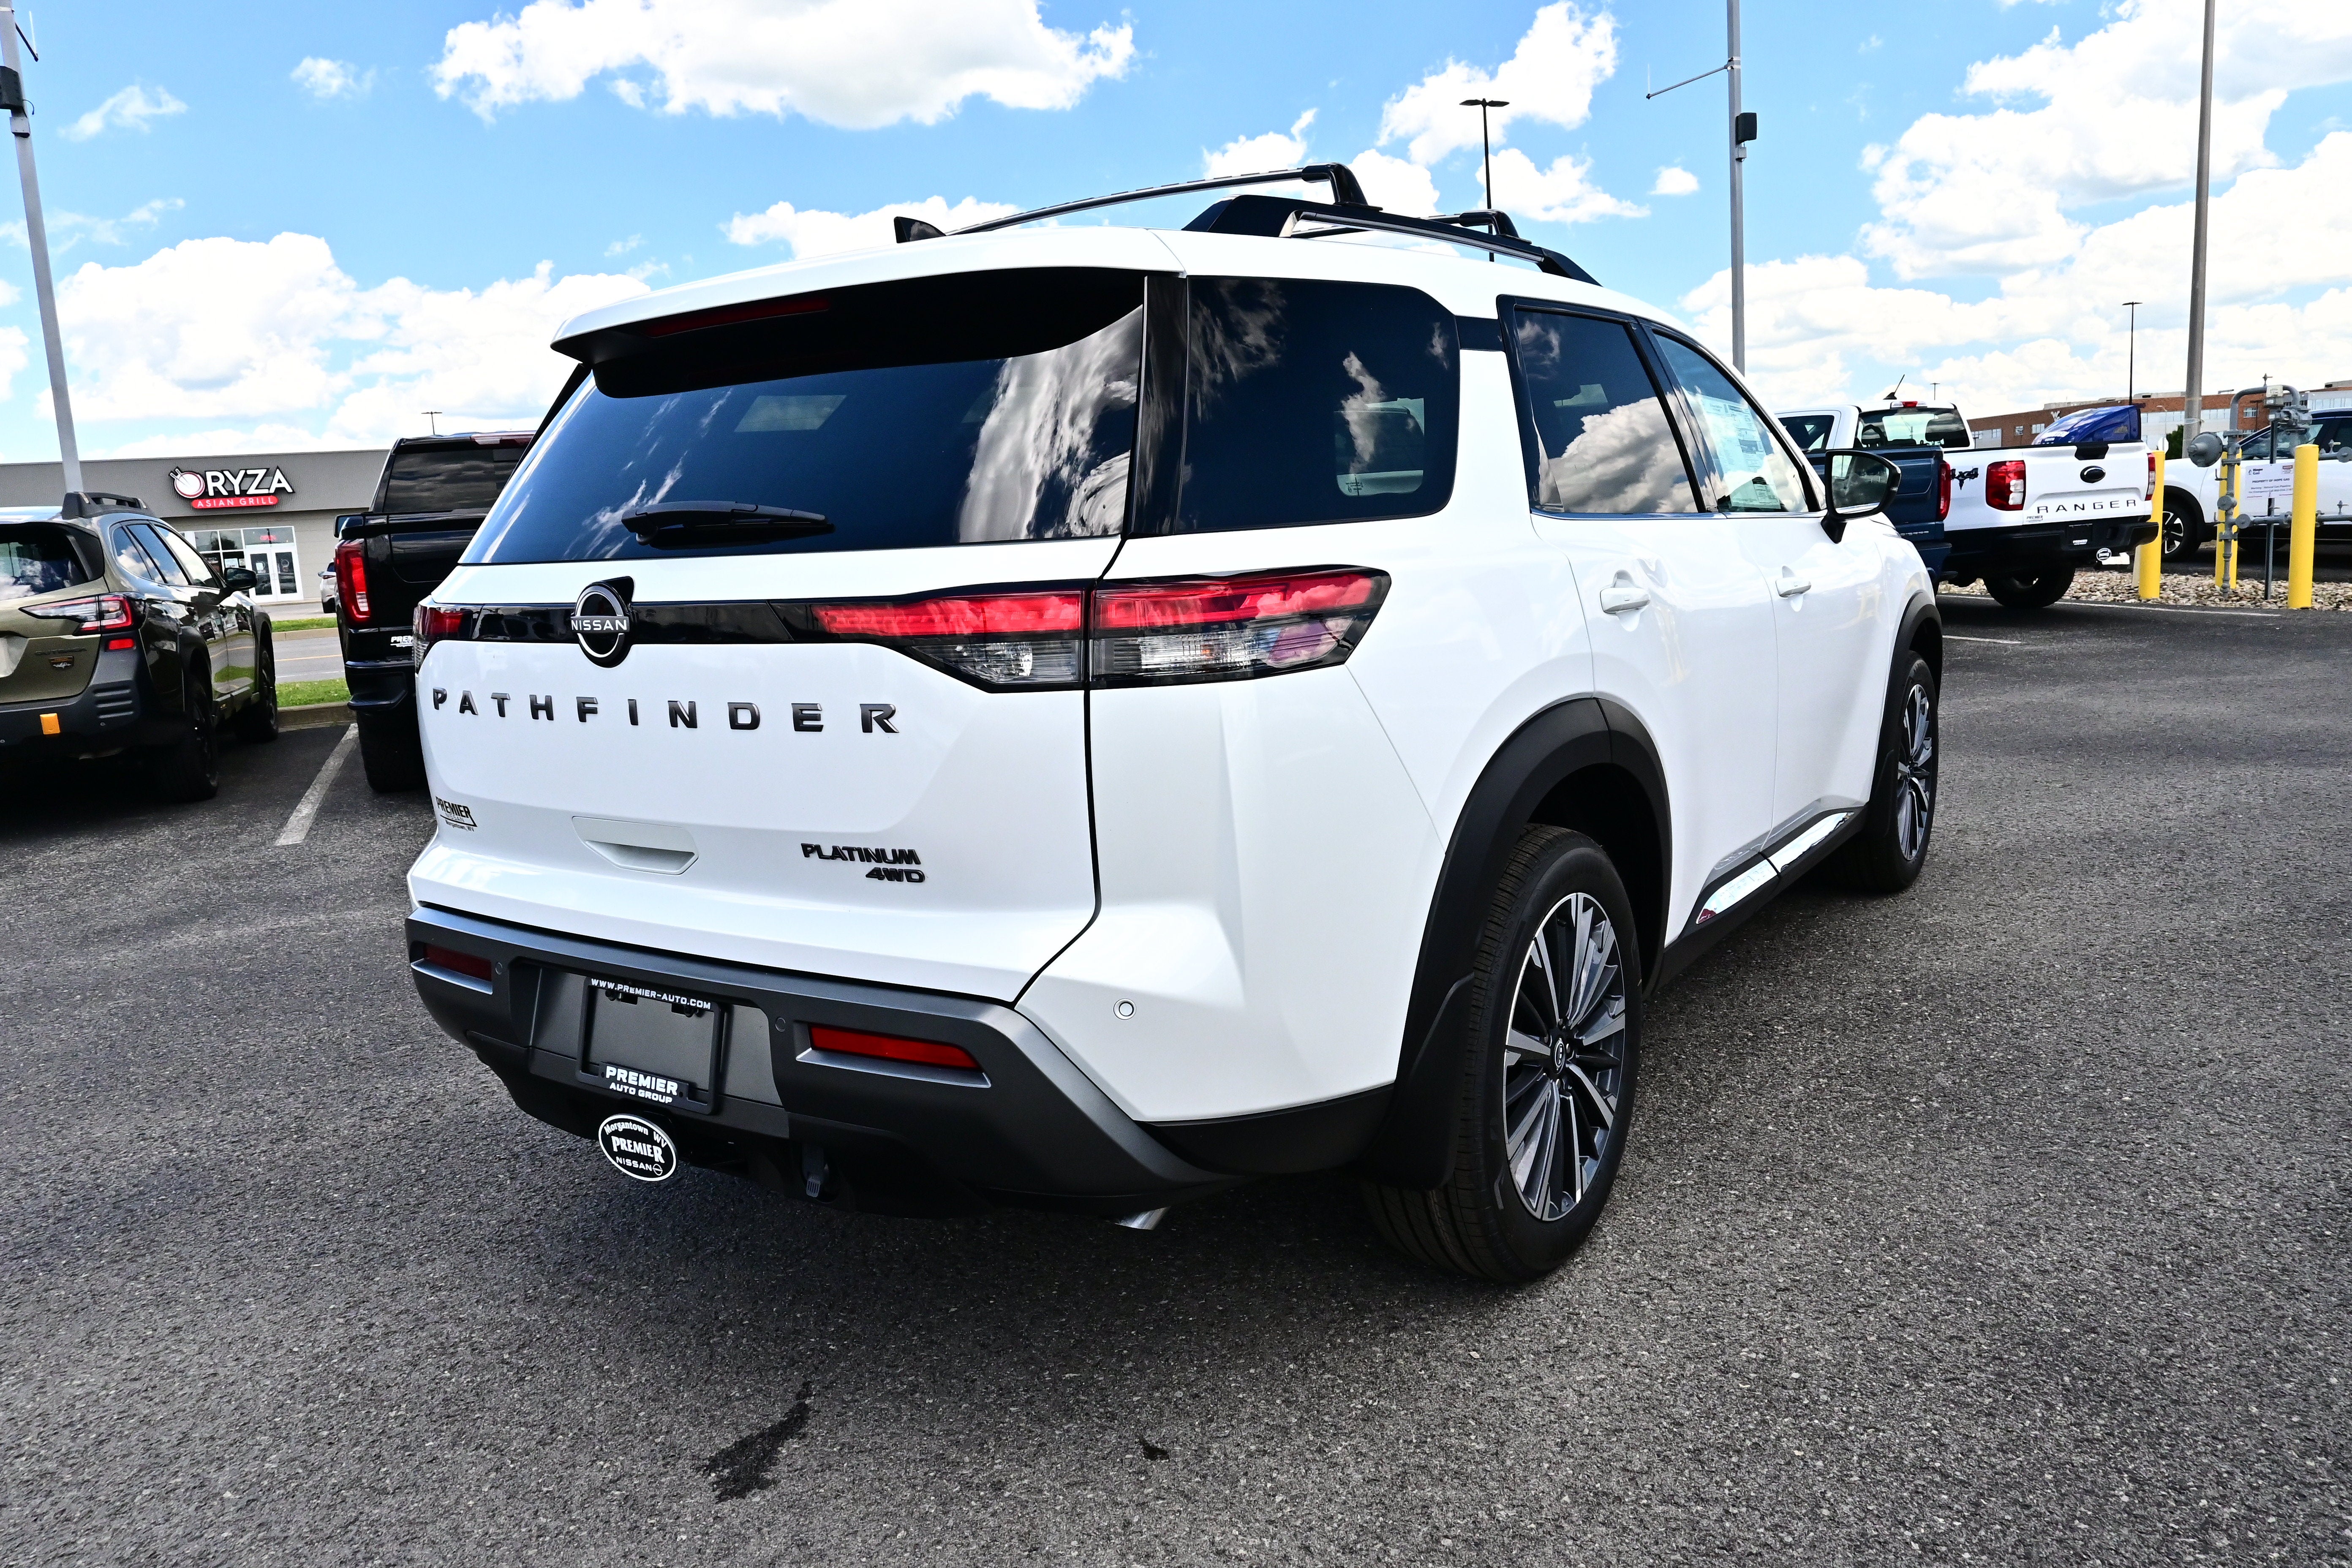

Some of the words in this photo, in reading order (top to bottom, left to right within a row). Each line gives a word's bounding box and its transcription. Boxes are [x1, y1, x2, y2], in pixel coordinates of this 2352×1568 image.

[197, 498, 234, 507] ASIAN
[240, 497, 274, 505] GRILL
[2037, 499, 2136, 514] RANGER
[571, 619, 627, 630] NISSAN
[433, 687, 900, 734] PATHFINDER
[436, 796, 471, 818] PREMIER
[801, 843, 921, 865] PLATINUM
[866, 867, 926, 883] 4WD
[591, 978, 711, 1010] WWW.PREMIER-AUTO.COM
[606, 1066, 678, 1096] PREMIER
[610, 1082, 636, 1095] AUTO
[638, 1089, 673, 1104] GROUP
[604, 1122, 649, 1135] Morgantown
[653, 1131, 667, 1148] WV
[611, 1136, 665, 1163] PREMIER
[616, 1157, 653, 1171] NISSAN
